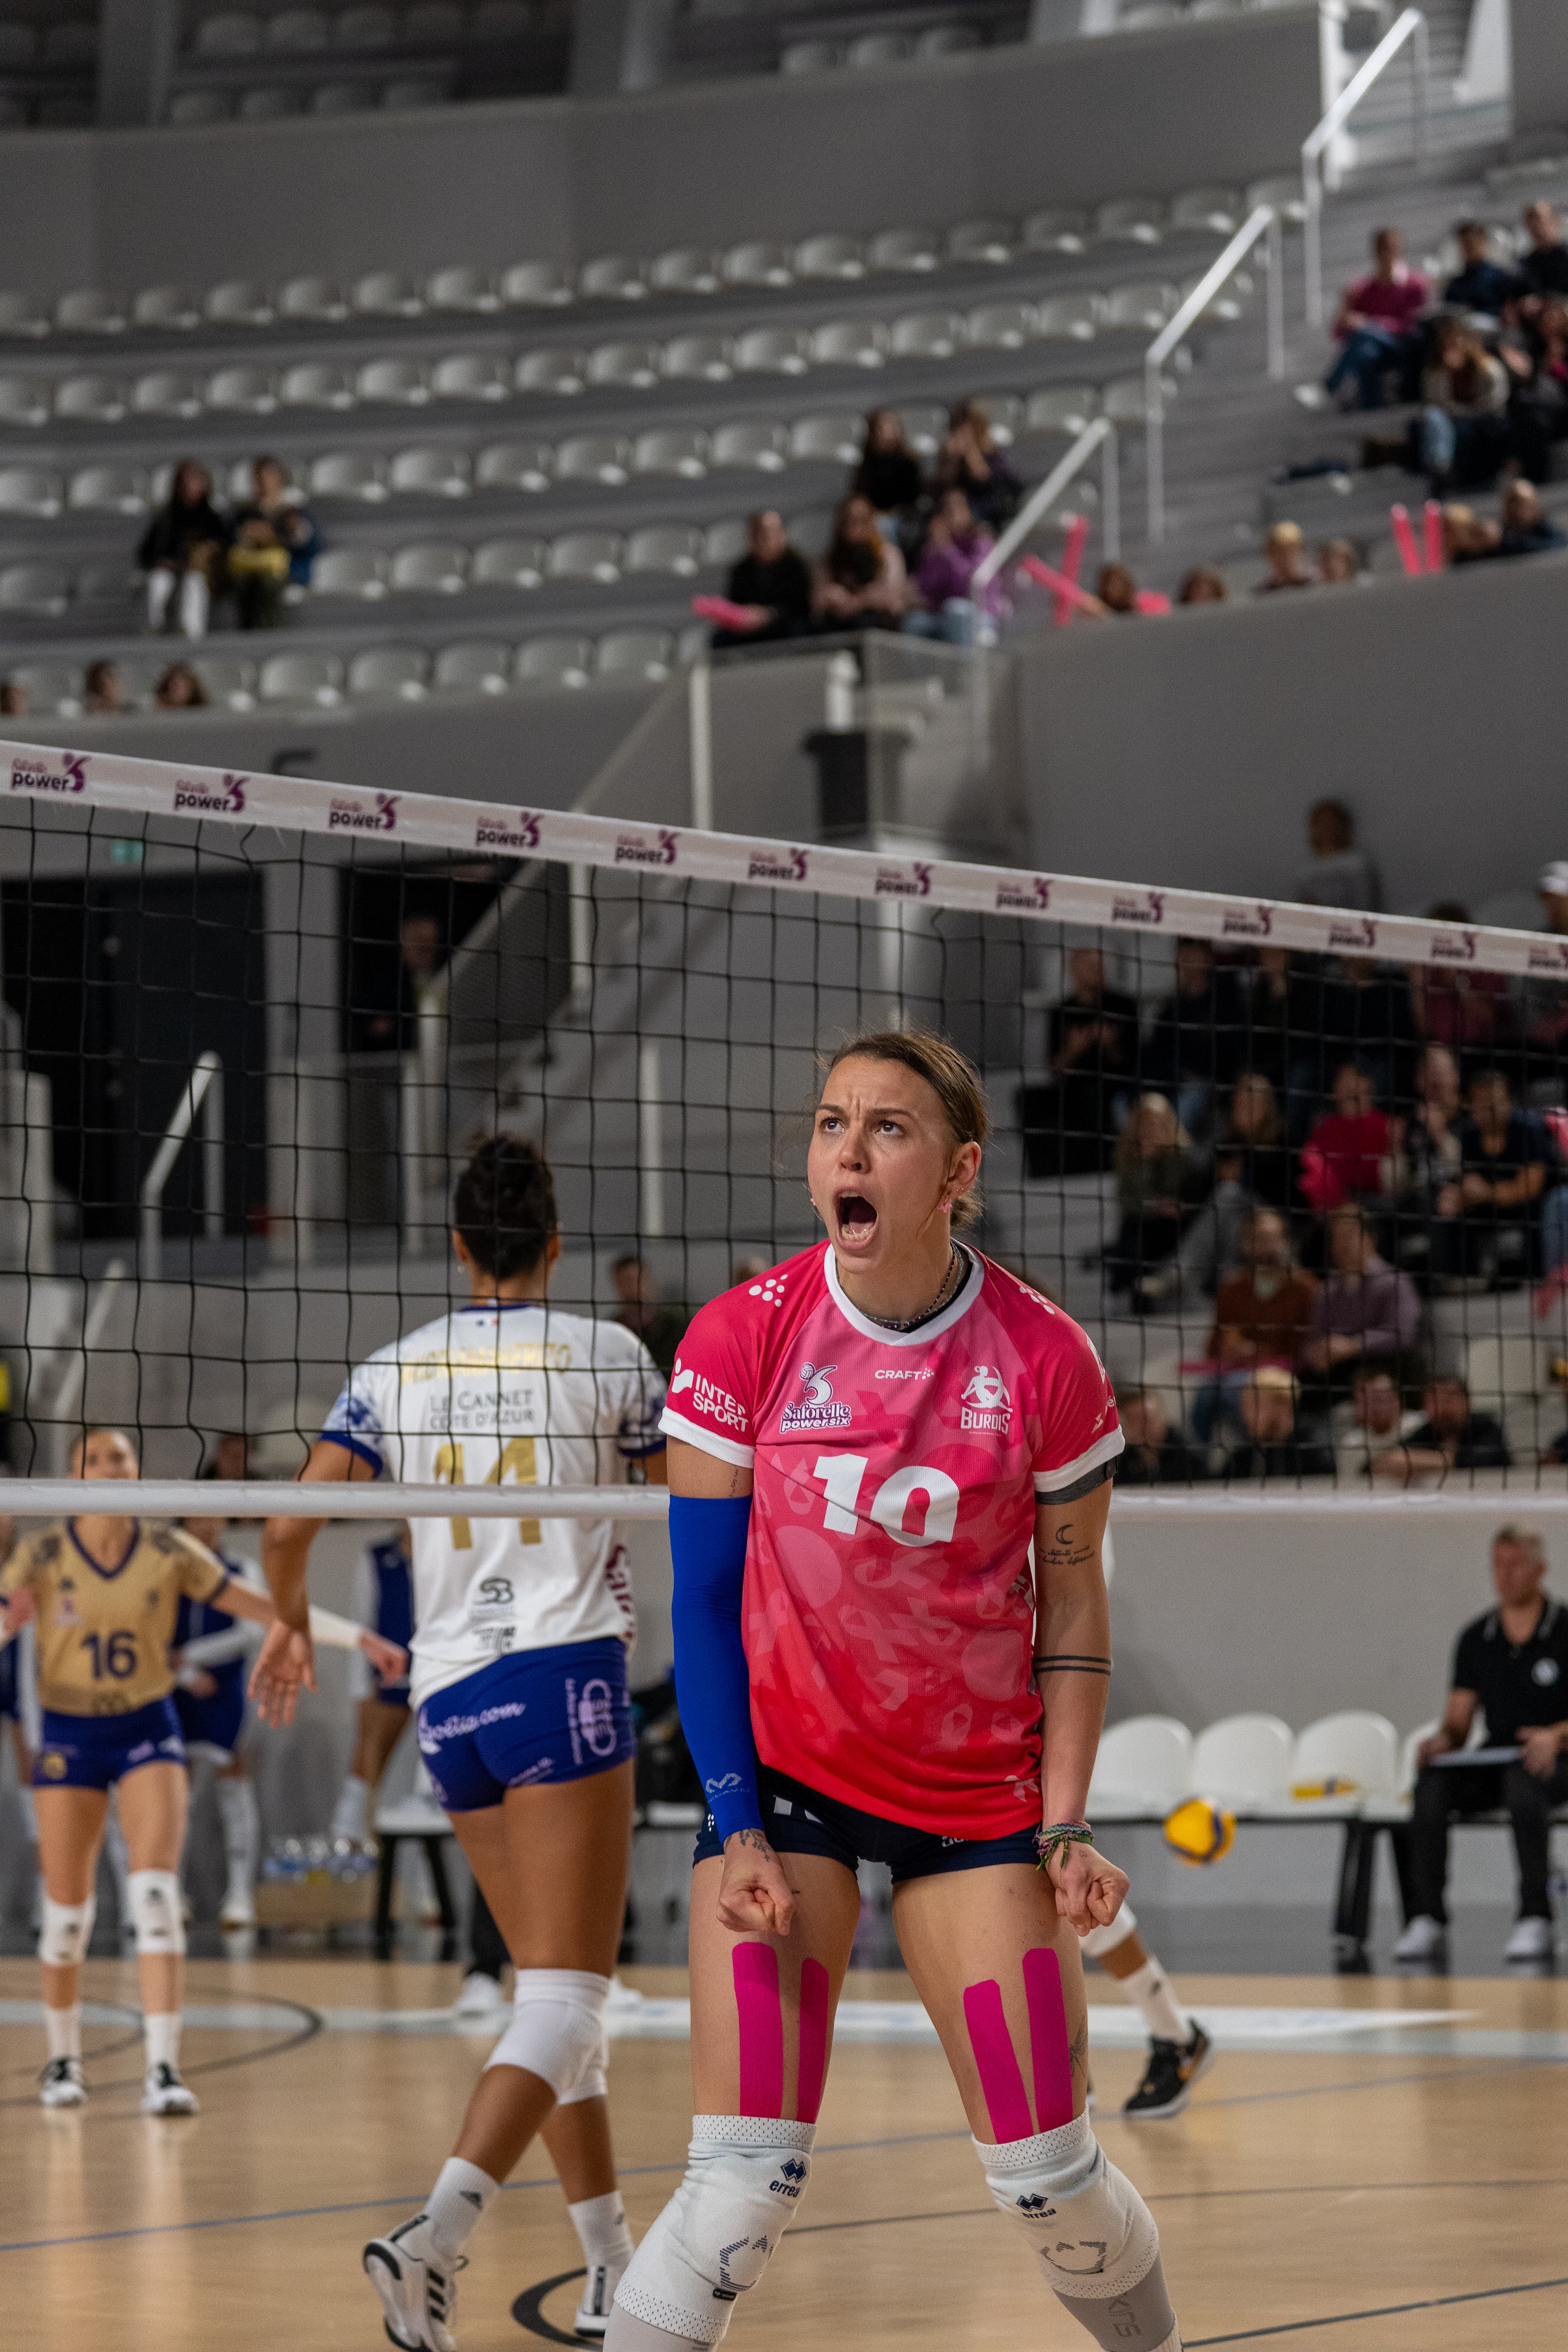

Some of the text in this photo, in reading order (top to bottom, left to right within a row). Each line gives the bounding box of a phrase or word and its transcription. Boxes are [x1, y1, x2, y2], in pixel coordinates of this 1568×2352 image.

[11, 772, 69, 790] power
[175, 793, 230, 811] power
[330, 811, 381, 829] power
[476, 829, 526, 847] power
[875, 1370, 922, 1380] CRAFT
[457, 1389, 534, 1411] CANNET
[693, 1392, 749, 1432] SPORT
[782, 1402, 850, 1420] Saforelle
[960, 1406, 1011, 1434] BURDIS
[781, 1417, 851, 1433] powersix
[813, 1453, 960, 1547] 10
[80, 1628, 138, 1679] 16
